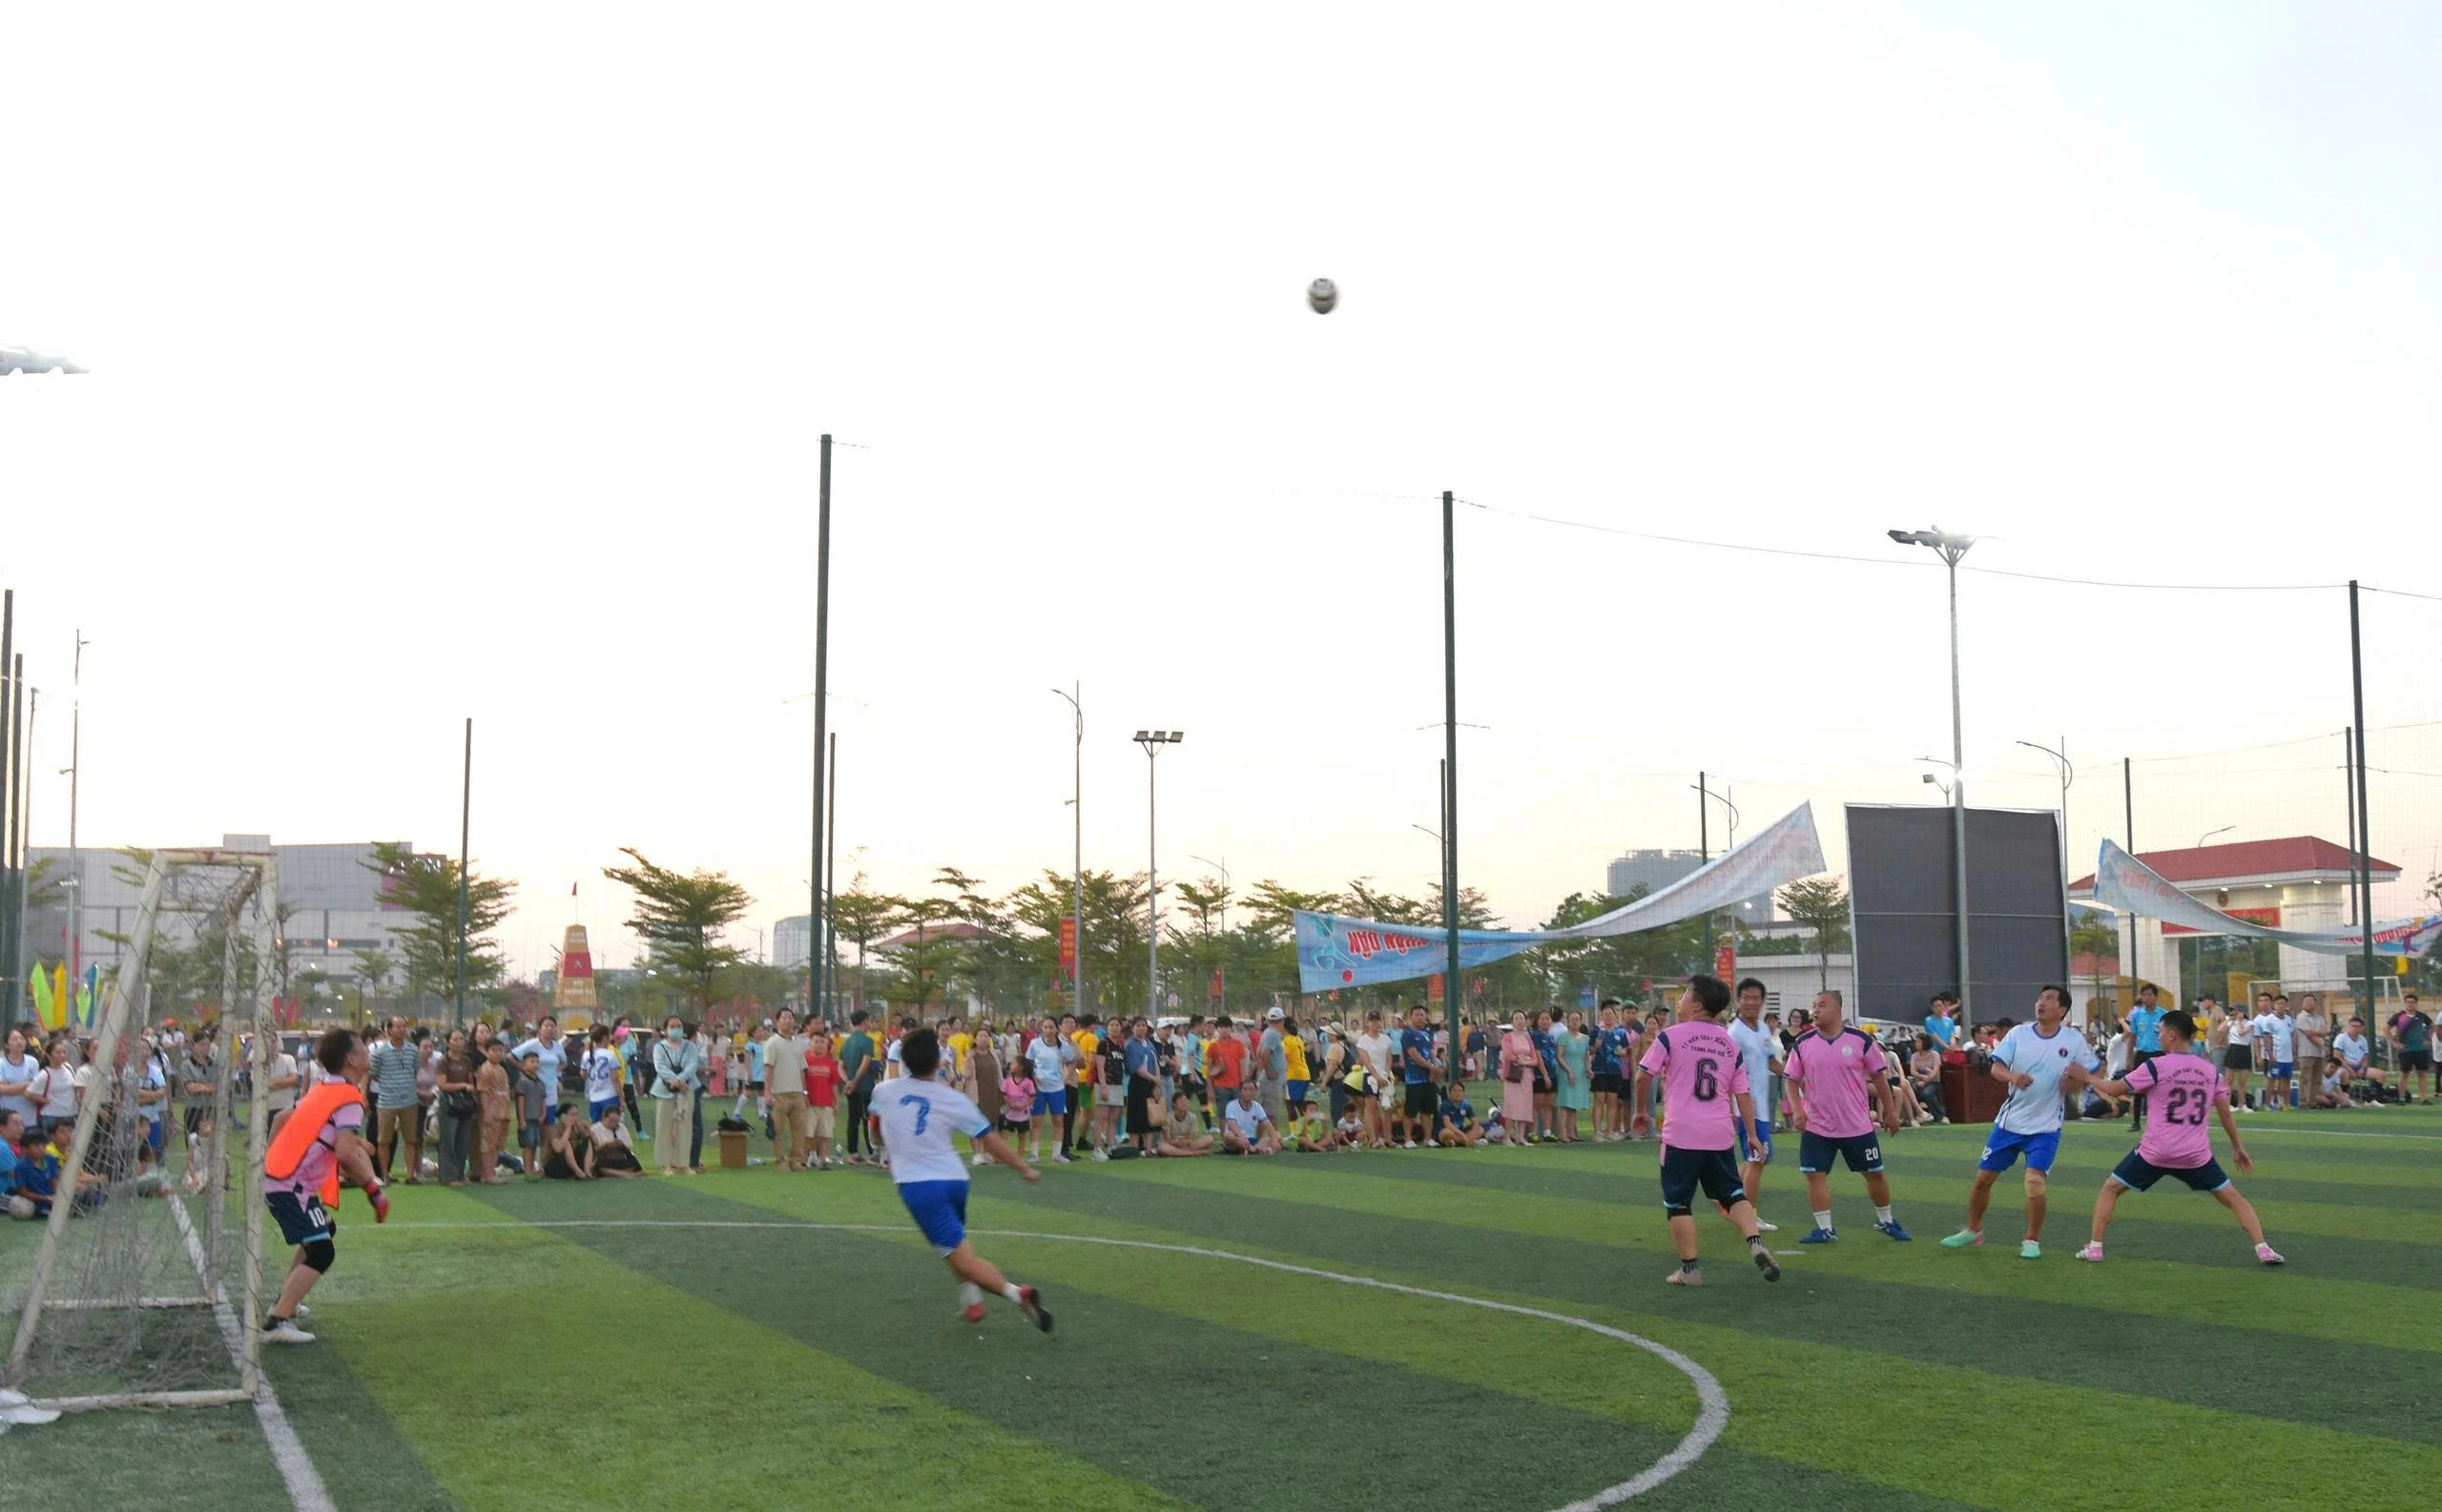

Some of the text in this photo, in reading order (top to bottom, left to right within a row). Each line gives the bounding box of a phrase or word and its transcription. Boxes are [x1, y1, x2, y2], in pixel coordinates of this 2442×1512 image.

[1347, 931, 1381, 959] DÂN
[1694, 1058, 1718, 1102] 6
[900, 1094, 931, 1136] 7
[2166, 1087, 2207, 1126] 23
[1865, 1147, 1879, 1161] 20
[308, 1207, 325, 1228] 10
